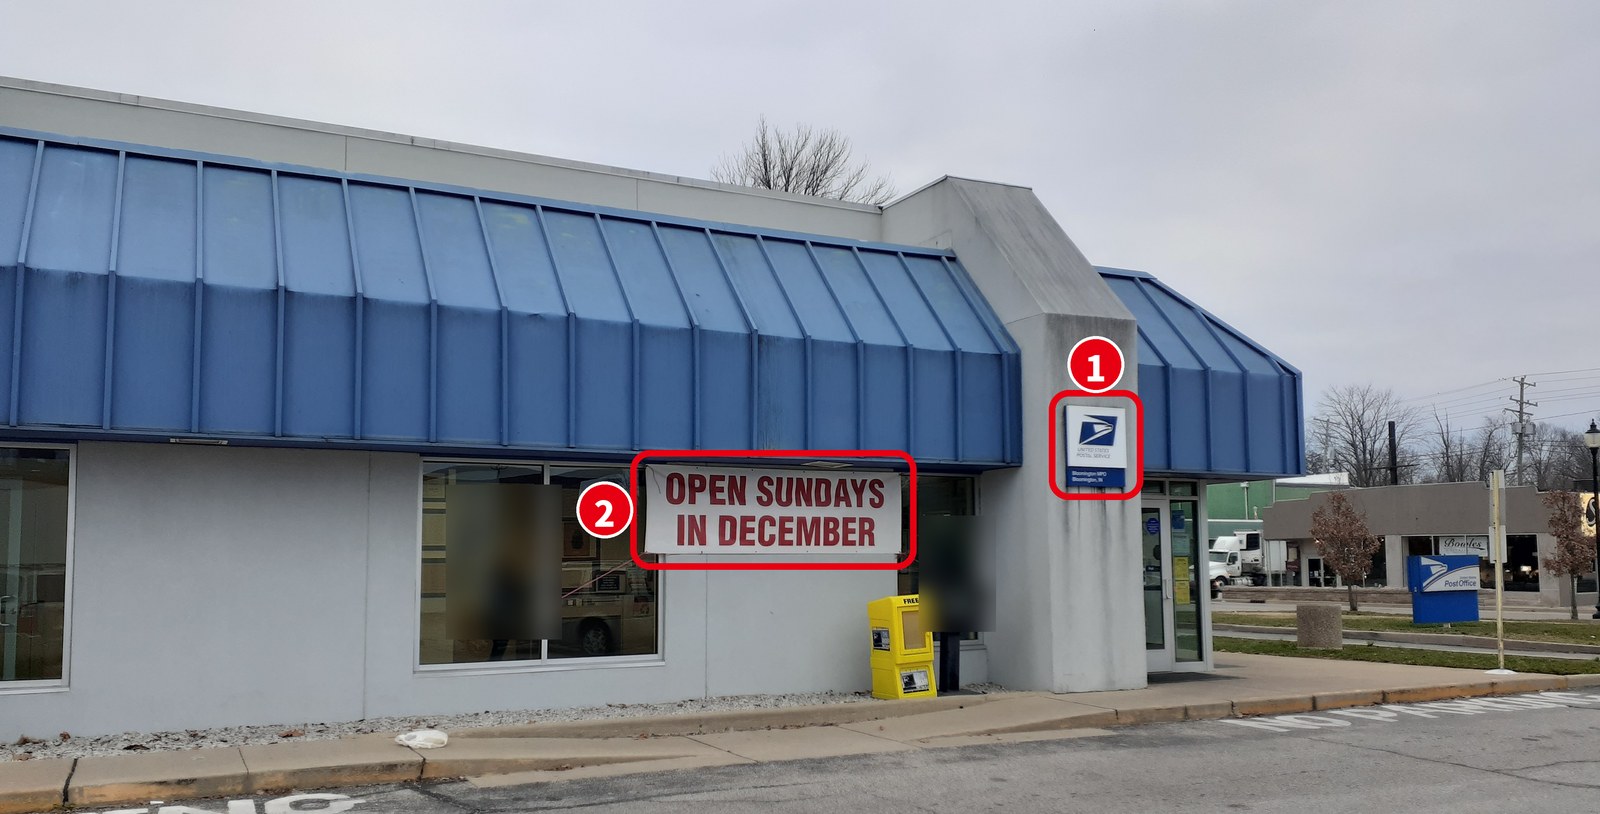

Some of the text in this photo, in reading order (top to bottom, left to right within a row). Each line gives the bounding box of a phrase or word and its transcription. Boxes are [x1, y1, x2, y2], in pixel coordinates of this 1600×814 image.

[665, 472, 885, 509] OPEN SUNDAYS
[676, 514, 876, 547] IN DECEMBER
[1459, 579, 1477, 587] Office
[1217, 714, 1352, 732] NO
